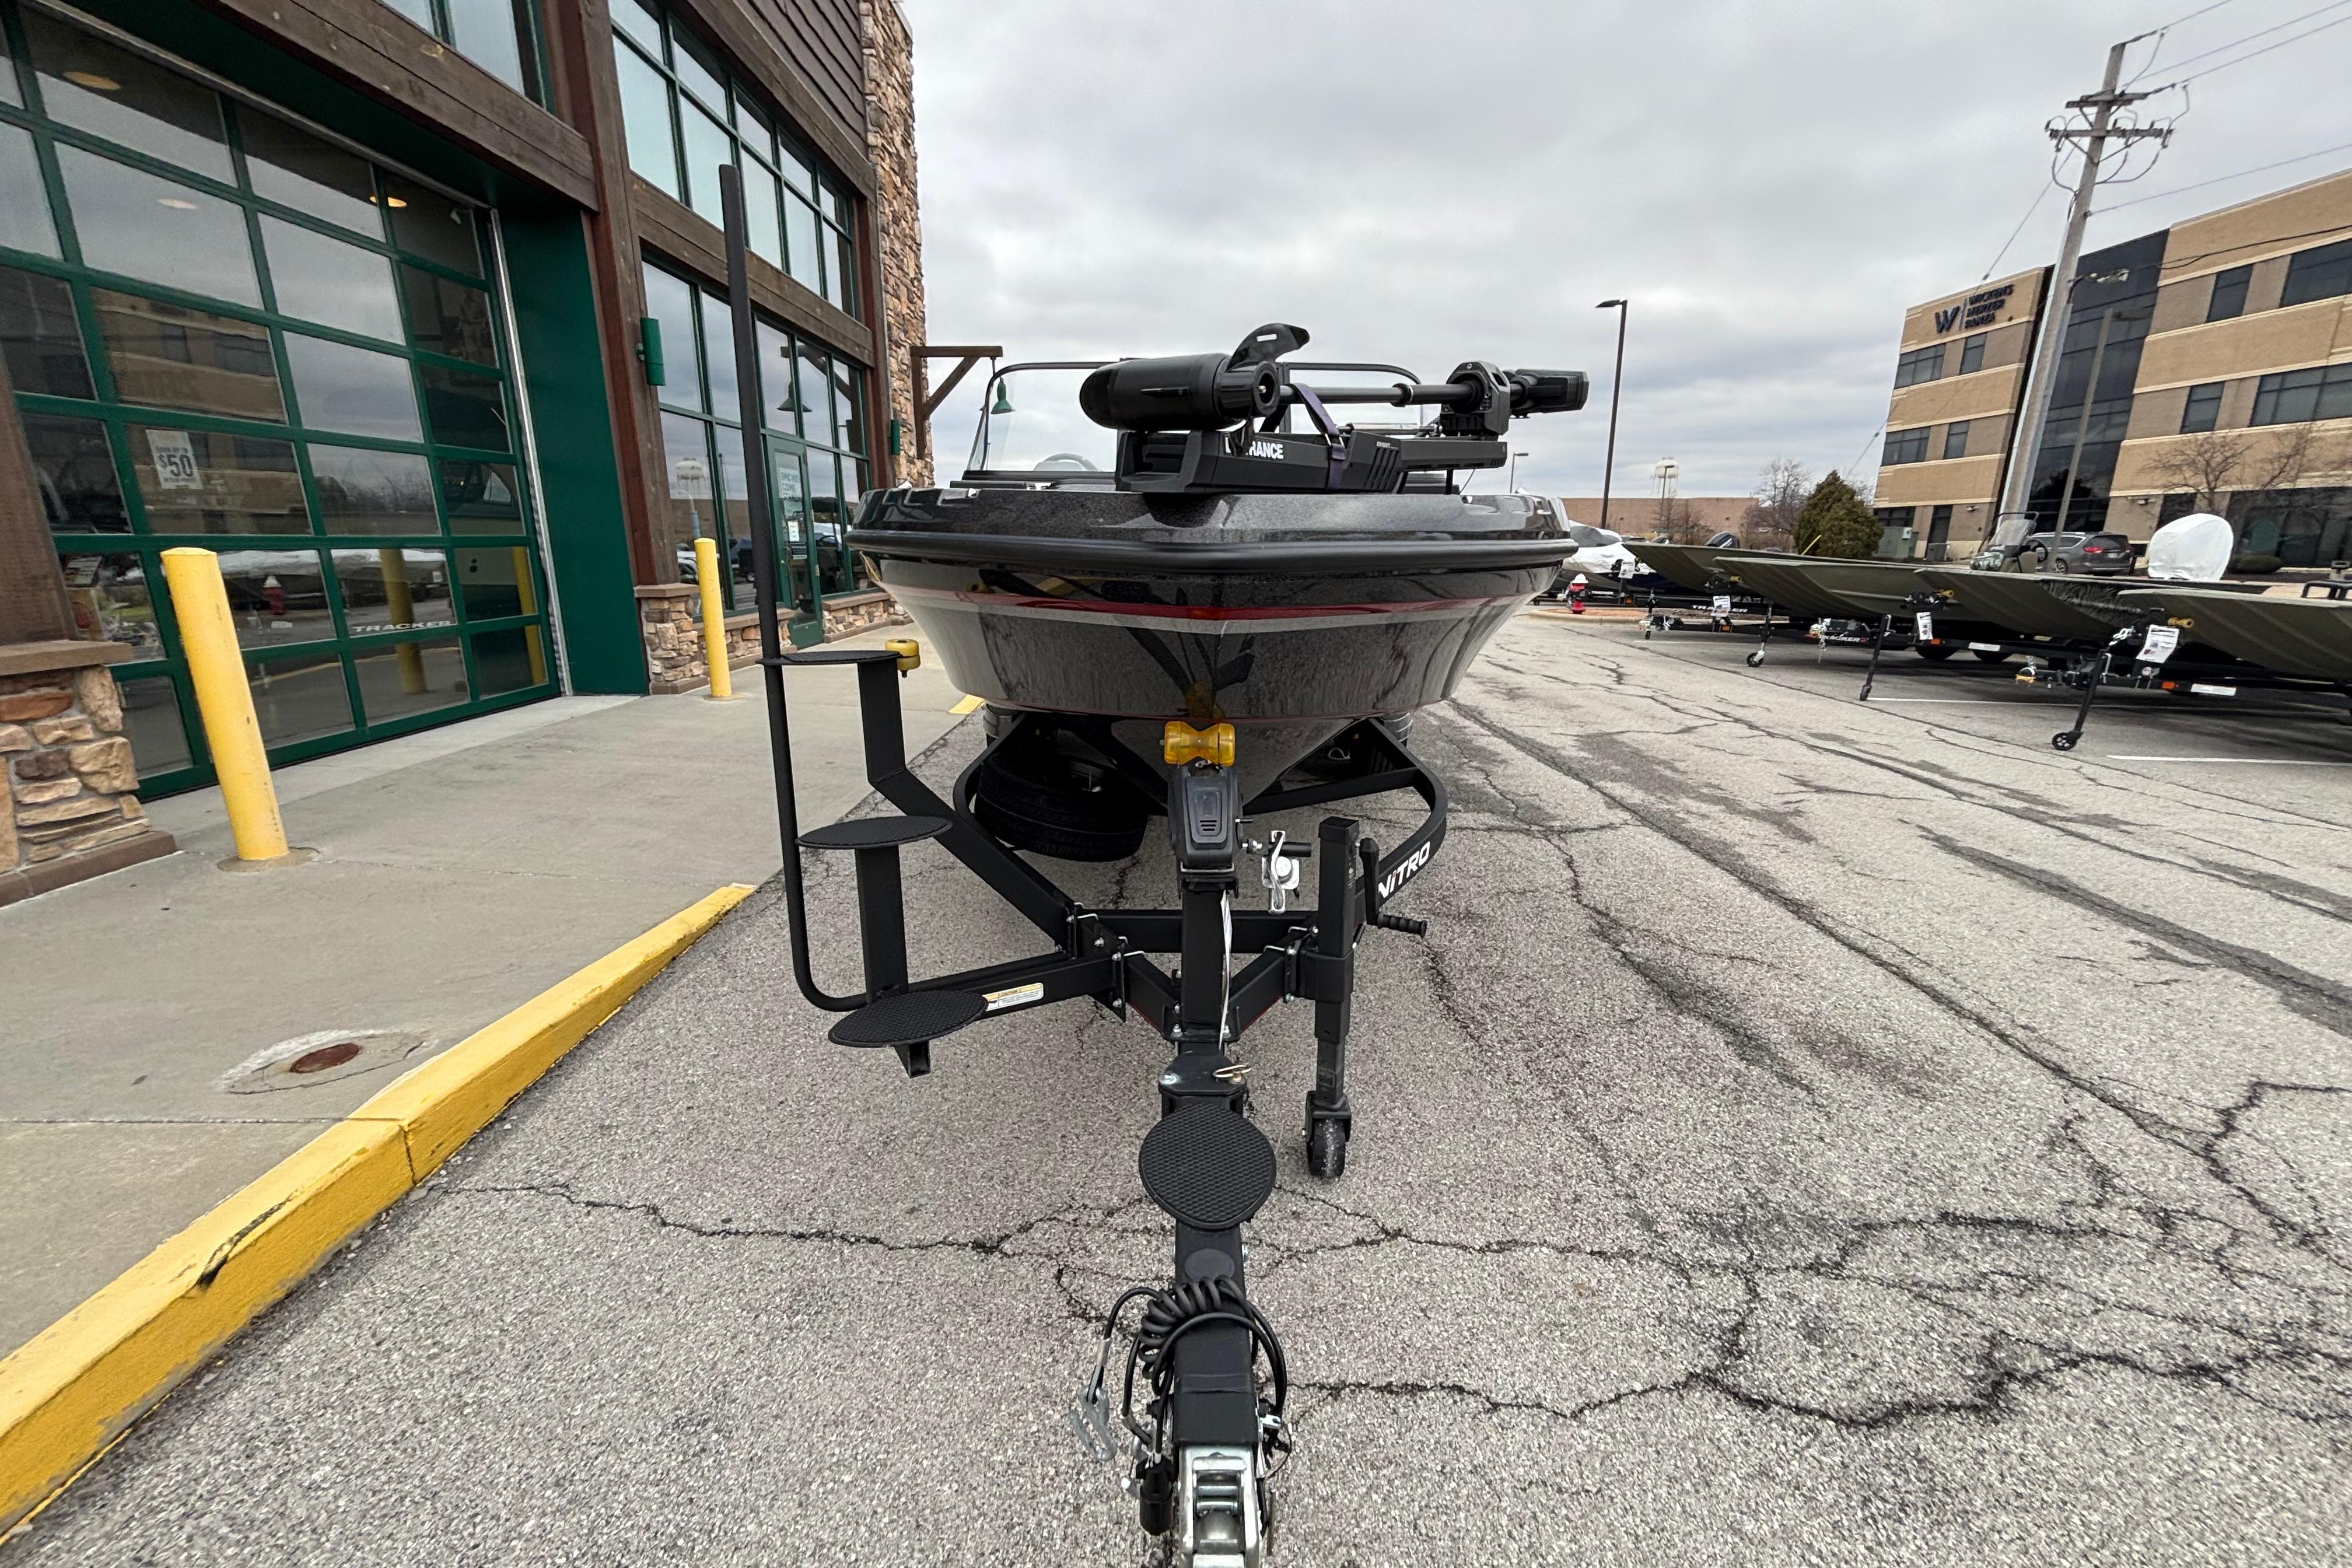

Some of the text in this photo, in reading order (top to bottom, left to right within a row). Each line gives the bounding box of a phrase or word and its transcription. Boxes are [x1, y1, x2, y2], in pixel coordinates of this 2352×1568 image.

[1934, 306, 1960, 333] W
[1224, 436, 1284, 459] LRANCE
[158, 453, 194, 477] $50
[352, 620, 451, 633] TRACKER
